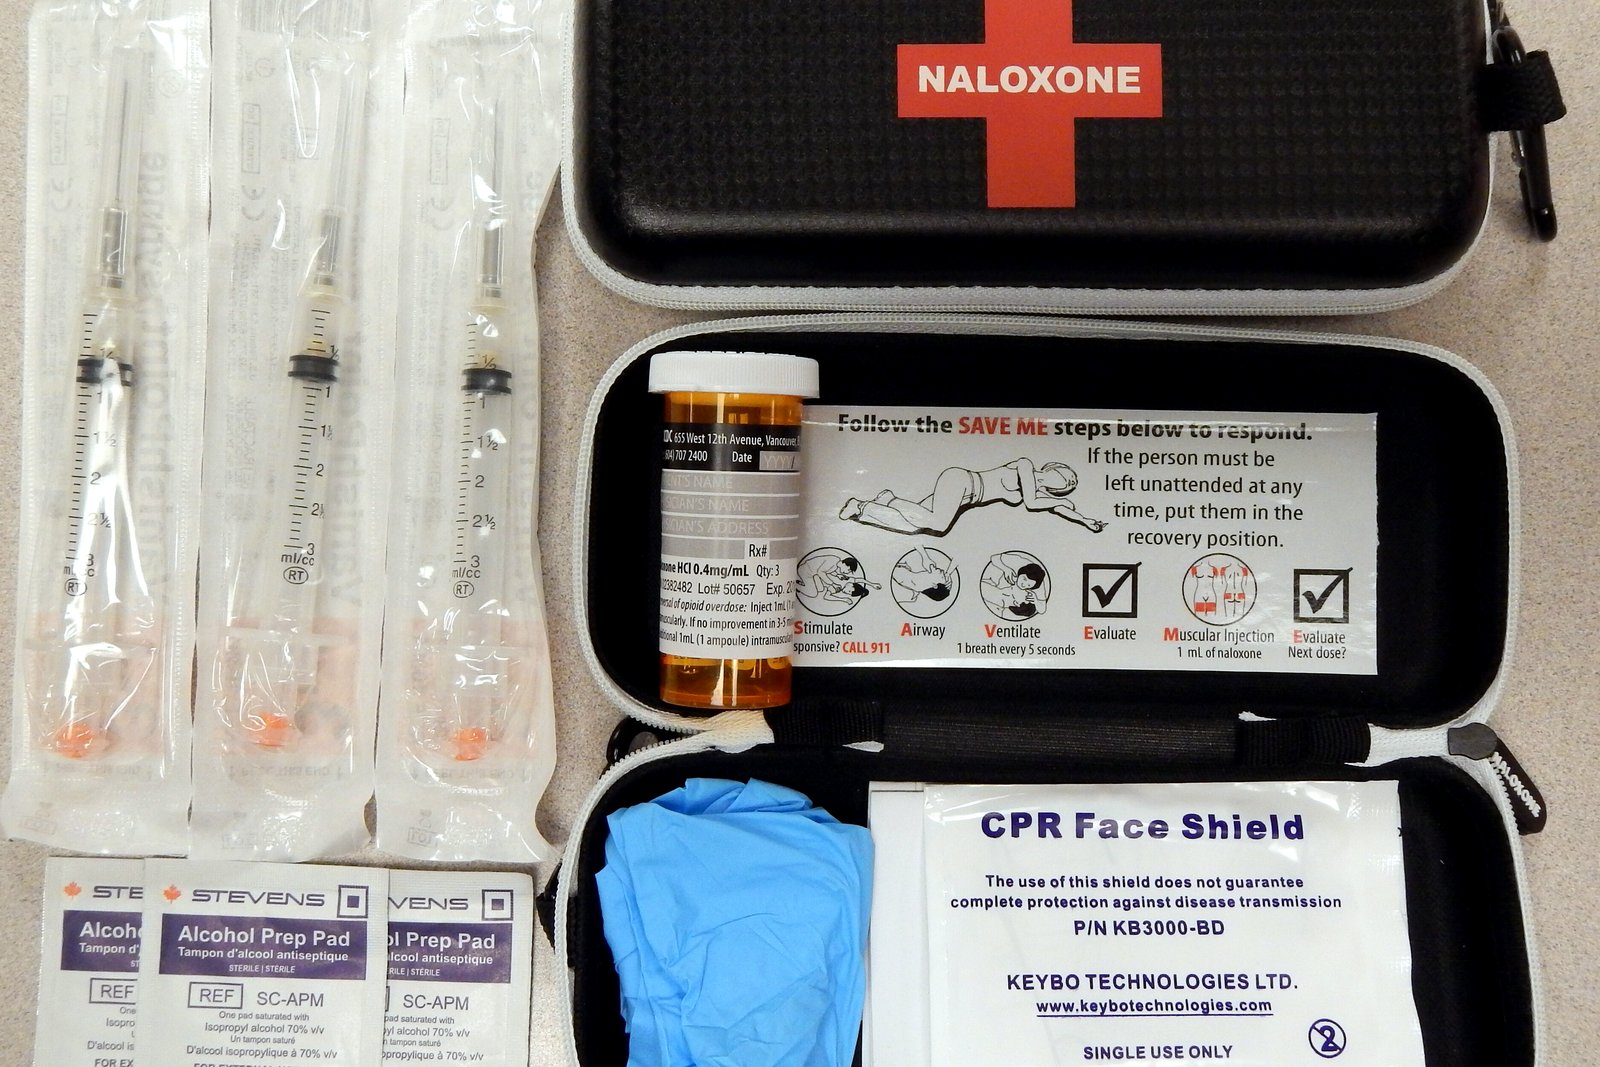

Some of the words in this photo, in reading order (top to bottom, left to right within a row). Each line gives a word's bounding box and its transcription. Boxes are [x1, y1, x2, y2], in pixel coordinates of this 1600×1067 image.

[919, 66, 1140, 93] NALOXONE
[326, 387, 331, 398] 1
[839, 414, 910, 433] Follow
[916, 416, 953, 433] the
[959, 417, 1010, 434] SAVE
[1016, 418, 1048, 435] ME
[1054, 421, 1111, 440] steps
[1117, 420, 1182, 438] below
[1190, 424, 1212, 438] to
[1218, 423, 1312, 443] respond.
[674, 433, 685, 443] 655
[687, 433, 705, 444] West
[708, 434, 727, 444] 12th
[730, 434, 764, 446] Avenue,
[675, 450, 686, 460] 707
[688, 451, 708, 461] 2400
[732, 452, 752, 462] Date
[1088, 448, 1101, 463] If
[1104, 450, 1133, 464] the
[1139, 451, 1198, 468] person
[1203, 452, 1248, 466] must
[1254, 451, 1275, 466] be
[317, 464, 324, 476] 2
[90, 472, 101, 485] 2
[476, 475, 484, 488] 2
[694, 476, 733, 488] NAME
[1105, 475, 1134, 490] left
[1140, 476, 1243, 493] unattended
[1249, 480, 1266, 493] at
[1271, 481, 1302, 498] any
[709, 500, 749, 511] NAME
[1114, 502, 1159, 520] time,
[1166, 504, 1195, 522] put
[1200, 504, 1246, 519] them
[1253, 504, 1268, 519] in
[1274, 505, 1303, 520] the
[708, 521, 769, 534] ADDRESS
[1128, 532, 1201, 548] recovery
[1208, 531, 1284, 548] position.
[307, 544, 314, 555] 3
[749, 544, 767, 557] Rx#
[281, 553, 314, 566] ml/cc
[471, 555, 480, 567] 3
[694, 564, 749, 579] 0.4mg/mL
[756, 565, 773, 580] Qty:
[775, 565, 779, 576] 3
[698, 583, 720, 594] Lot#
[723, 584, 755, 595] 50657
[767, 583, 784, 596] Exp.
[674, 598, 680, 609] of
[681, 599, 704, 611] opioid
[706, 602, 746, 612] overdose:
[751, 602, 772, 615] Inject
[690, 618, 697, 627] If
[710, 618, 767, 630] improvement
[769, 617, 776, 628] in
[777, 617, 786, 628] 3-5
[794, 621, 853, 635] Stimulate
[901, 623, 946, 639] Airway
[984, 624, 1041, 638] Ventilate
[1084, 626, 1136, 640] Evaluate
[1164, 628, 1221, 642] Muscular
[1224, 628, 1274, 643] Injection
[1293, 630, 1346, 644] Evaluate
[680, 633, 694, 644] 1mL
[697, 635, 704, 645] (1
[707, 635, 749, 647] ampoule)
[842, 642, 868, 653] CALL
[871, 643, 890, 653] 911
[958, 643, 962, 653] 1
[965, 643, 997, 654] breath
[999, 645, 1026, 657] every
[1029, 644, 1034, 654] 5
[1037, 644, 1075, 655] seconds
[1178, 648, 1182, 658] 1
[1188, 648, 1202, 658] mL
[1206, 648, 1216, 658] of
[1217, 648, 1262, 659] naloxone
[1288, 646, 1312, 658] Next
[1316, 647, 1346, 659] dose?
[981, 812, 1061, 839] CPR
[1075, 813, 1169, 839] Face
[1182, 814, 1304, 840] Shield
[986, 875, 1014, 888] The
[1018, 877, 1045, 888] use
[1050, 875, 1066, 888] of
[1069, 875, 1099, 889] this
[1103, 875, 1150, 889] shield
[1155, 876, 1192, 889] does
[1197, 876, 1221, 889] not
[1226, 876, 1304, 892] guarantee
[192, 889, 325, 906] STEVENS
[951, 895, 1023, 910] complete
[1028, 895, 1108, 911] protection
[1113, 896, 1171, 911] against
[1175, 895, 1235, 908] disease
[1239, 896, 1341, 908] transmission
[80, 922, 142, 939] Alcoh
[1074, 920, 1107, 935] P/N
[1113, 921, 1225, 936] KB3000-BD
[178, 926, 254, 943] Alcohol
[261, 928, 306, 947] Prep
[313, 931, 350, 946] Pad
[407, 932, 451, 951] Prep
[459, 933, 495, 949] Pad
[79, 943, 125, 955] Tampon
[178, 947, 223, 959] Tampon
[227, 949, 273, 959] d'alcool
[276, 950, 349, 963] antiseptique
[422, 953, 493, 965] antiseptique
[411, 967, 440, 976] STÉRILE
[1007, 975, 1080, 991] KEYBO
[1086, 974, 1249, 990] TECHNOLOGIES
[1255, 974, 1298, 990] LTD.
[101, 985, 134, 999] REF
[200, 989, 234, 1003] REF
[257, 992, 325, 1007] SC-APM
[403, 995, 468, 1010] SC-APM
[1037, 1000, 1272, 1016] www.keybotechnologies.com
[219, 1011, 235, 1019] One
[238, 1012, 252, 1020] pad
[205, 1022, 248, 1033] Isopropyl
[251, 1023, 284, 1033] alcohol
[288, 1024, 308, 1033] 70%
[311, 1026, 324, 1034] v/v
[87, 1041, 125, 1051] D'alcool
[243, 1036, 270, 1044] tampon
[187, 1045, 222, 1055] D'alcool
[226, 1047, 288, 1058] isopropylique
[291, 1049, 296, 1057] à
[300, 1049, 320, 1058] 70%
[324, 1050, 337, 1058] v/v
[1084, 1046, 1146, 1059] SINGLE
[1150, 1046, 1184, 1059] USE
[1188, 1045, 1232, 1059] ONLY
